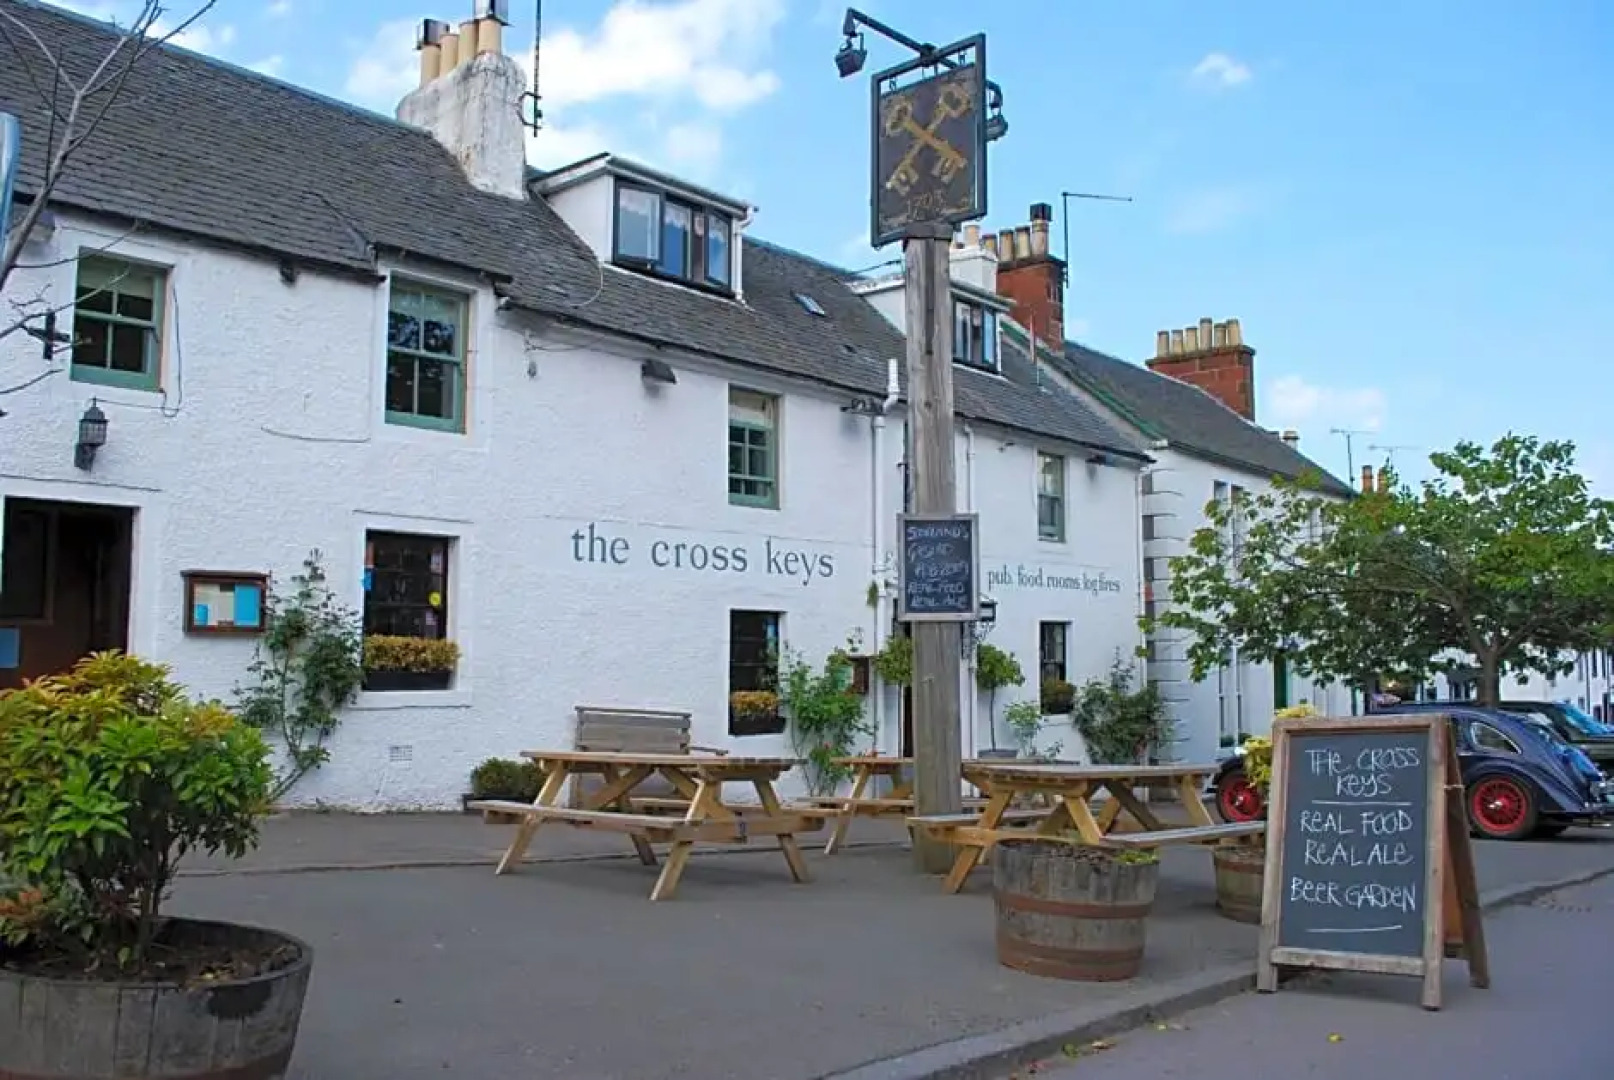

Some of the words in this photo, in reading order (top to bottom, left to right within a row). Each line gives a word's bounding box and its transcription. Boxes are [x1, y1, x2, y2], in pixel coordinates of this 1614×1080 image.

[571, 522, 630, 564] the
[651, 540, 748, 572] cross
[765, 536, 834, 586] keys
[1357, 747, 1420, 771] CROSS
[1360, 810, 1413, 836] FOOD
